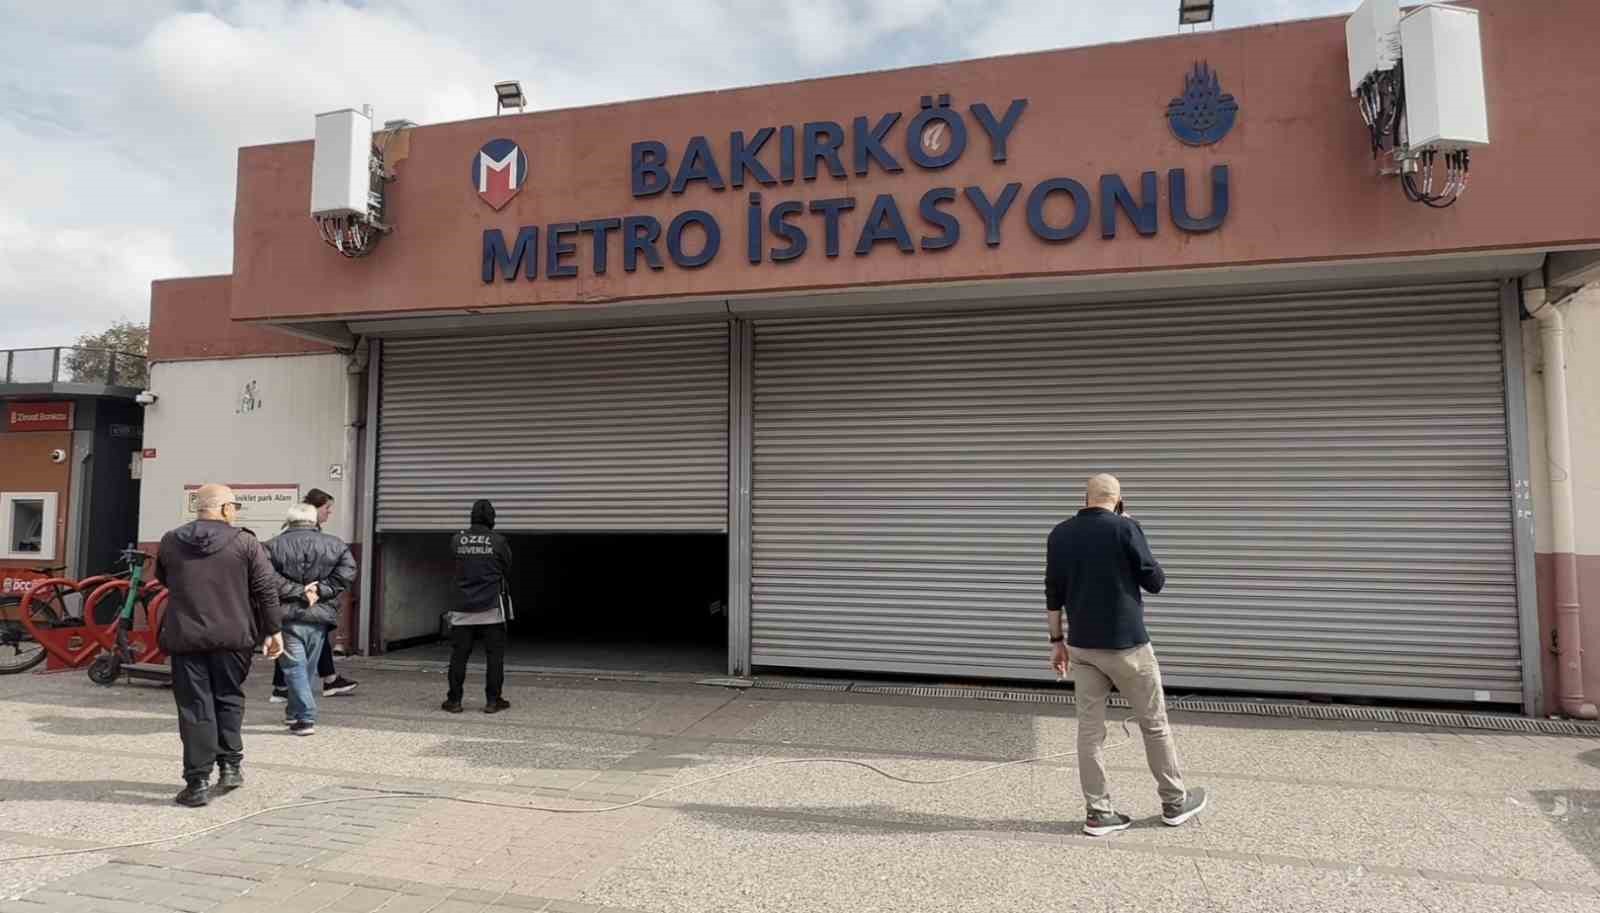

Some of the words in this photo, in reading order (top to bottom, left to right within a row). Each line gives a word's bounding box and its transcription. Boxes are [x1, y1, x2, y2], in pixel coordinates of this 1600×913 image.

[631, 93, 1028, 198] BAKIRKÖY
[482, 209, 721, 284] METRO
[748, 164, 1229, 265] İSTASYONU
